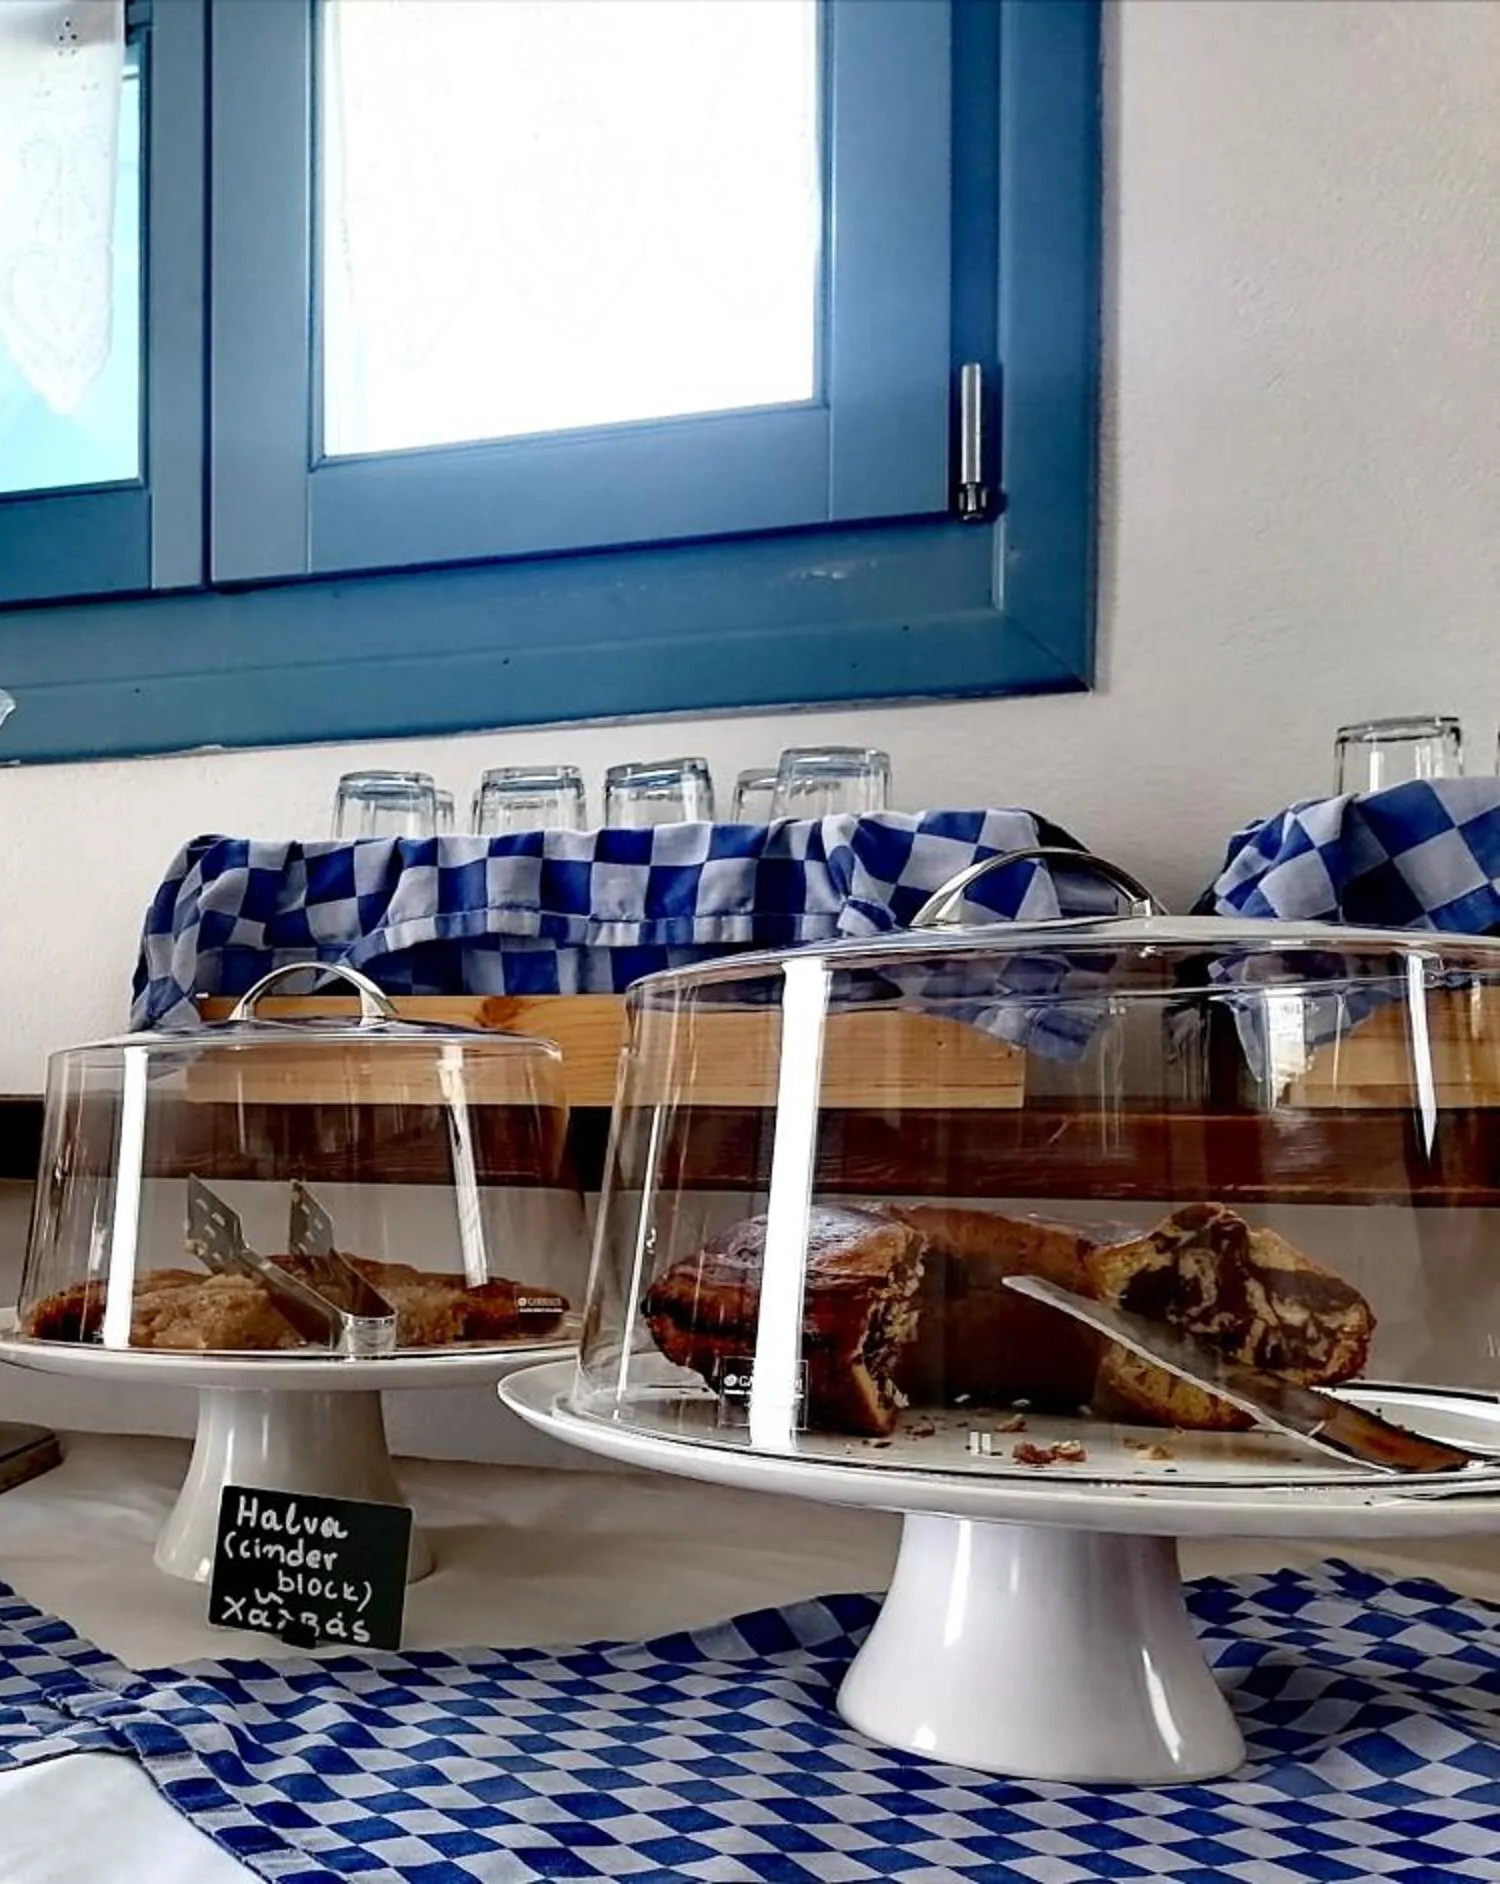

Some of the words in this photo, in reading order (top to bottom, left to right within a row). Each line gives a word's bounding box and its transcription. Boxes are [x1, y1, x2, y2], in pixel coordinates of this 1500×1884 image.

[236, 1494, 349, 1539] Halva
[223, 1530, 339, 1572] (cinder
[276, 1568, 373, 1613] block)
